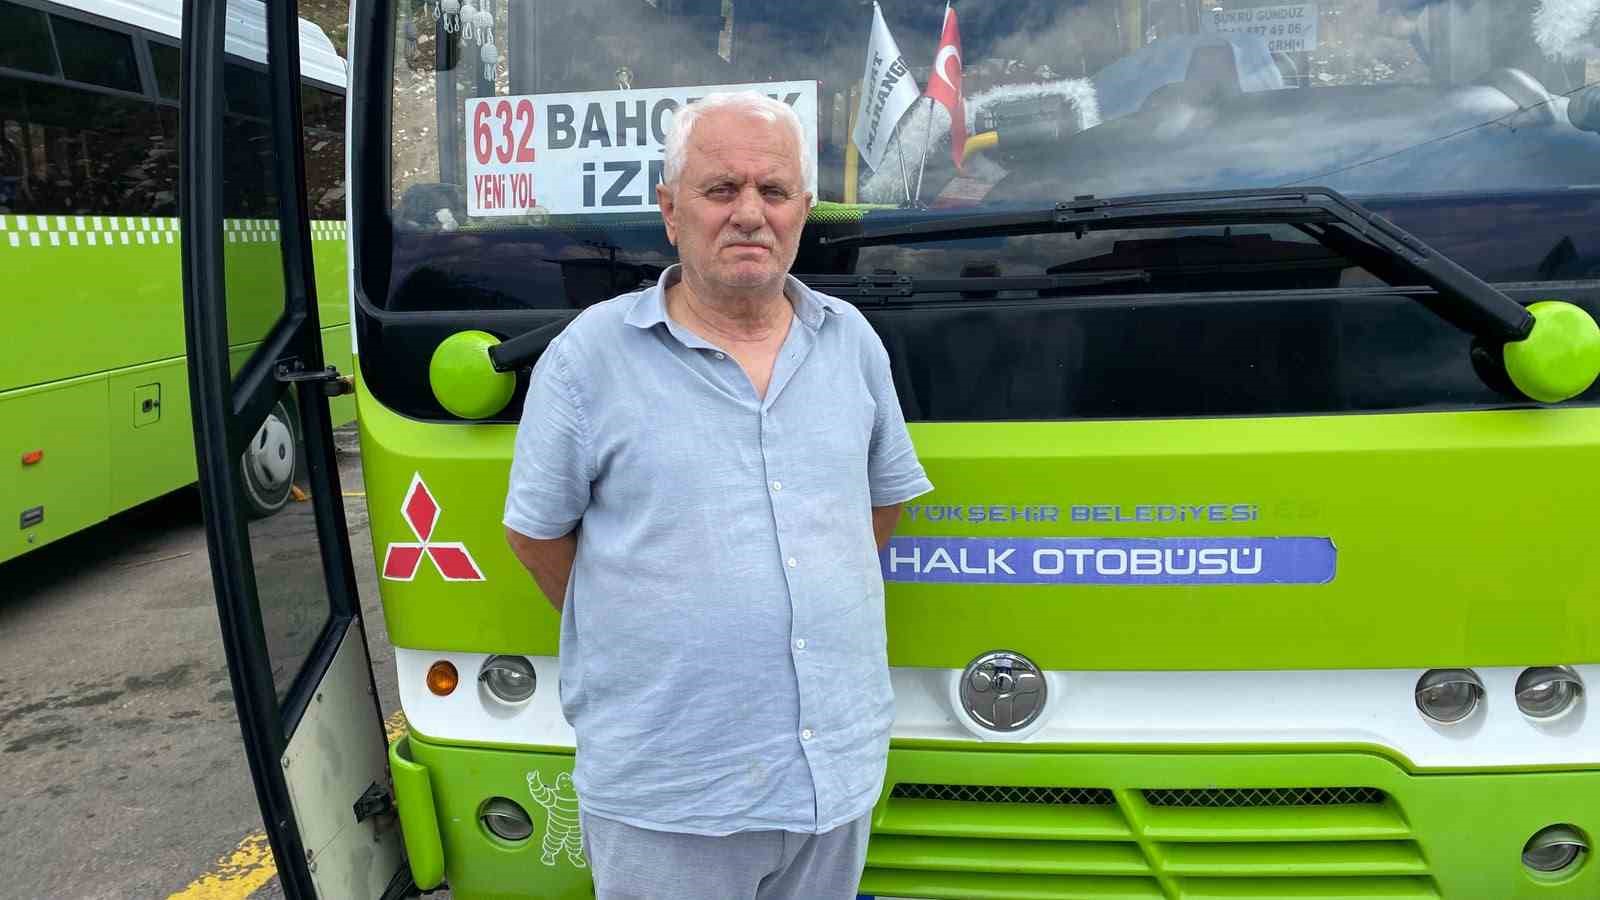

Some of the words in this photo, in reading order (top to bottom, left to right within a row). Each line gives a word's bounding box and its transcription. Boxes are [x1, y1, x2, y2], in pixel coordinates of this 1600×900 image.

[473, 100, 535, 165] 632
[509, 173, 536, 208] YOL
[890, 547, 1016, 575] HALK
[1032, 547, 1262, 575] OTOBÜSÜ
